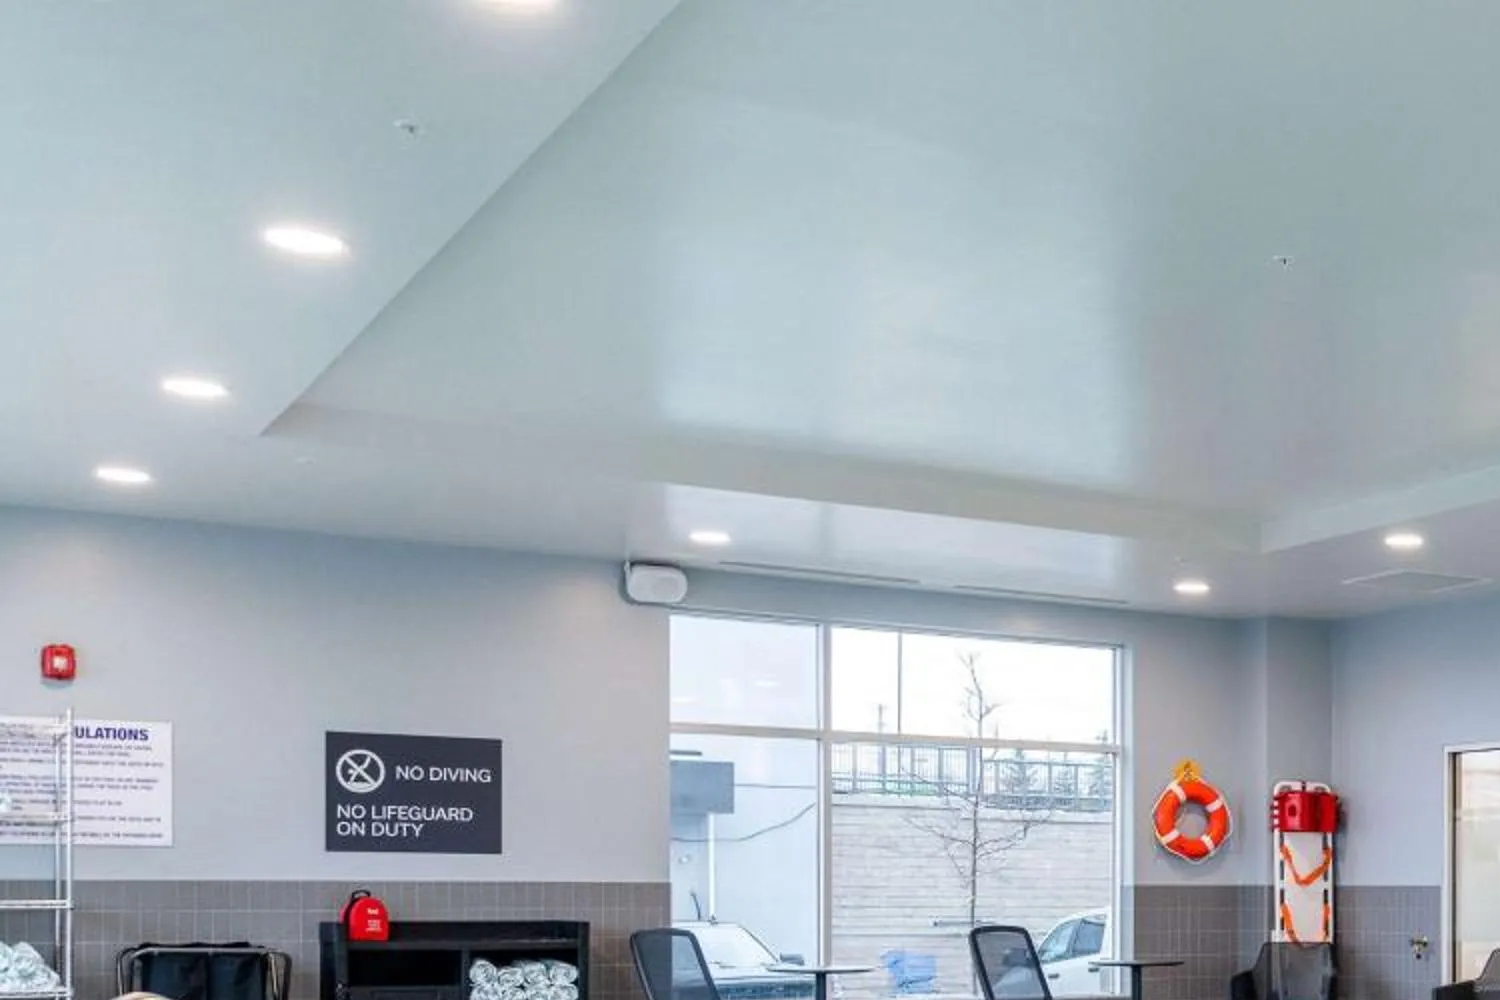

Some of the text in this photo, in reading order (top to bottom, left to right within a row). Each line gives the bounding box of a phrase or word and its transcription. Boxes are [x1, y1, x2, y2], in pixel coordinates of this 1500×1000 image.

[75, 726, 149, 741] ULATIONS
[395, 765, 492, 783] NO DIVING
[336, 804, 473, 822] NO LIFEGUARD
[336, 821, 424, 838] ON DUTY
